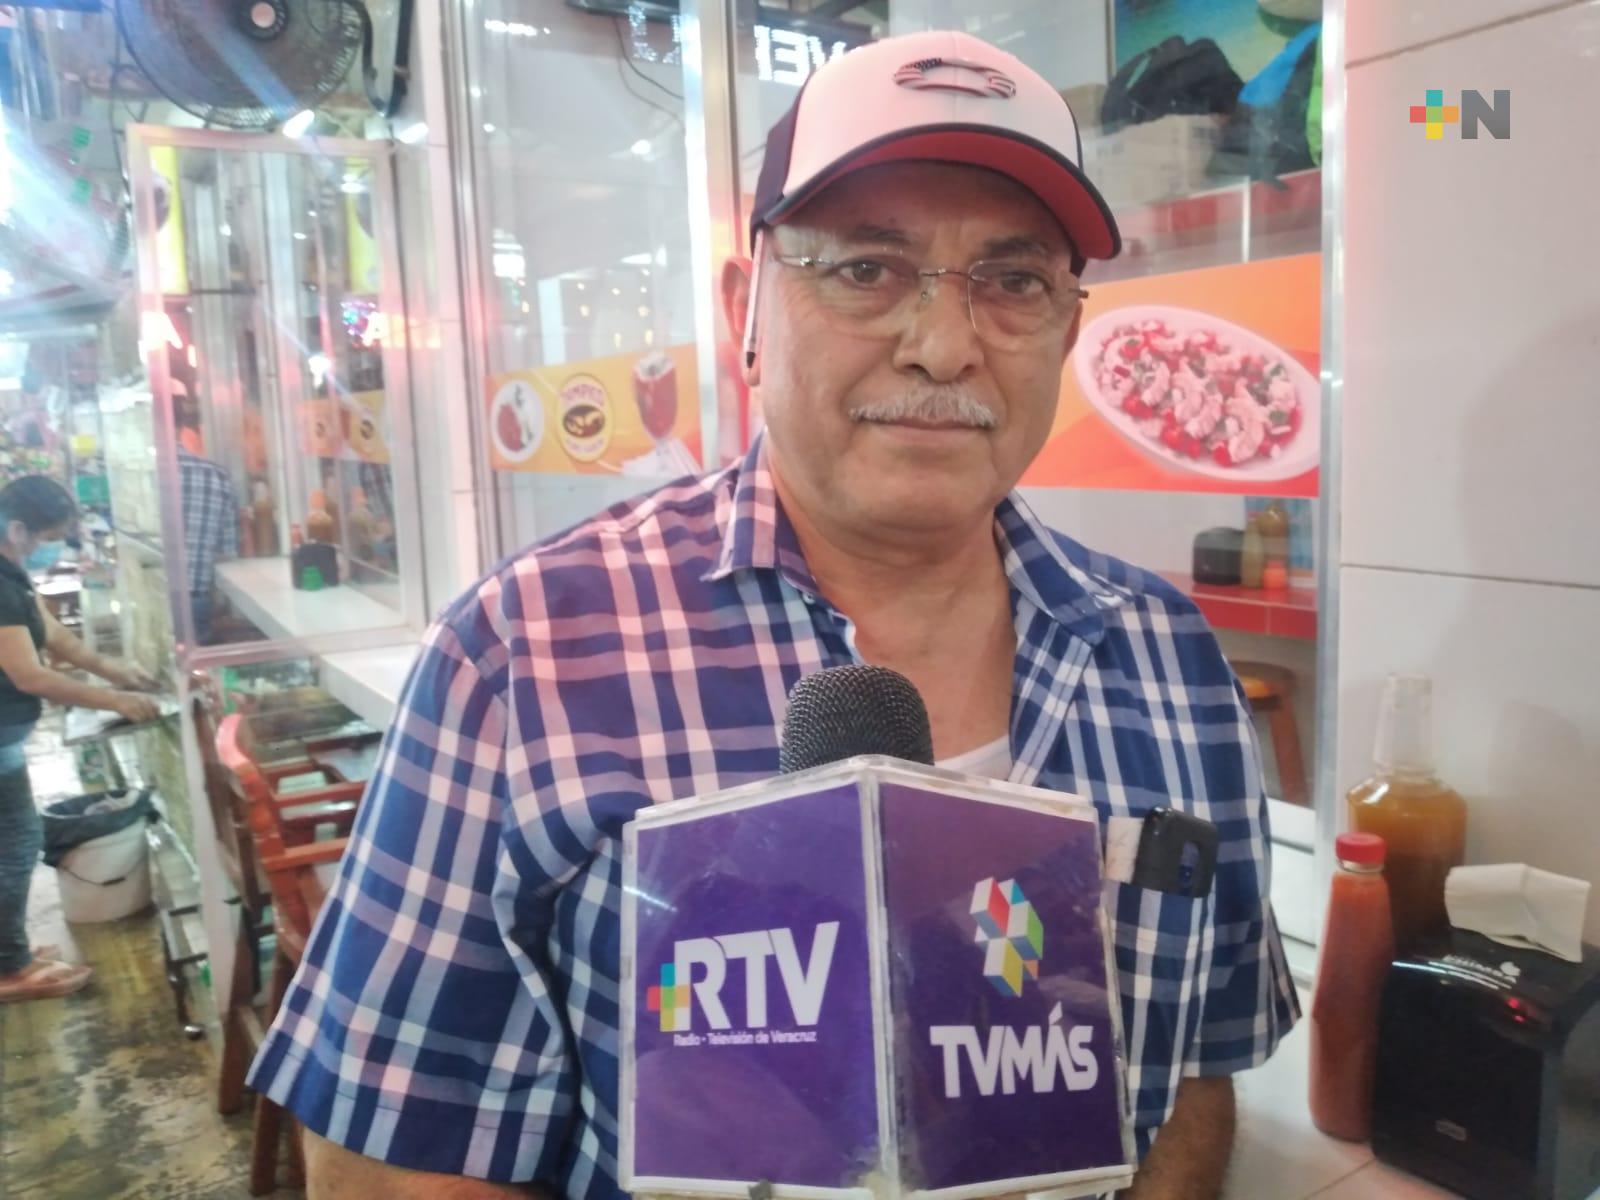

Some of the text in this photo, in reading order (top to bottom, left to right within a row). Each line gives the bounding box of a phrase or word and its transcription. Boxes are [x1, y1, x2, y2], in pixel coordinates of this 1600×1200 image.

[673, 921, 840, 1032] RTV
[673, 1033, 701, 1046] Radio
[755, 1030, 770, 1044] de
[770, 1030, 817, 1043] Veracruz
[929, 1000, 1099, 1099] TVMÁS
